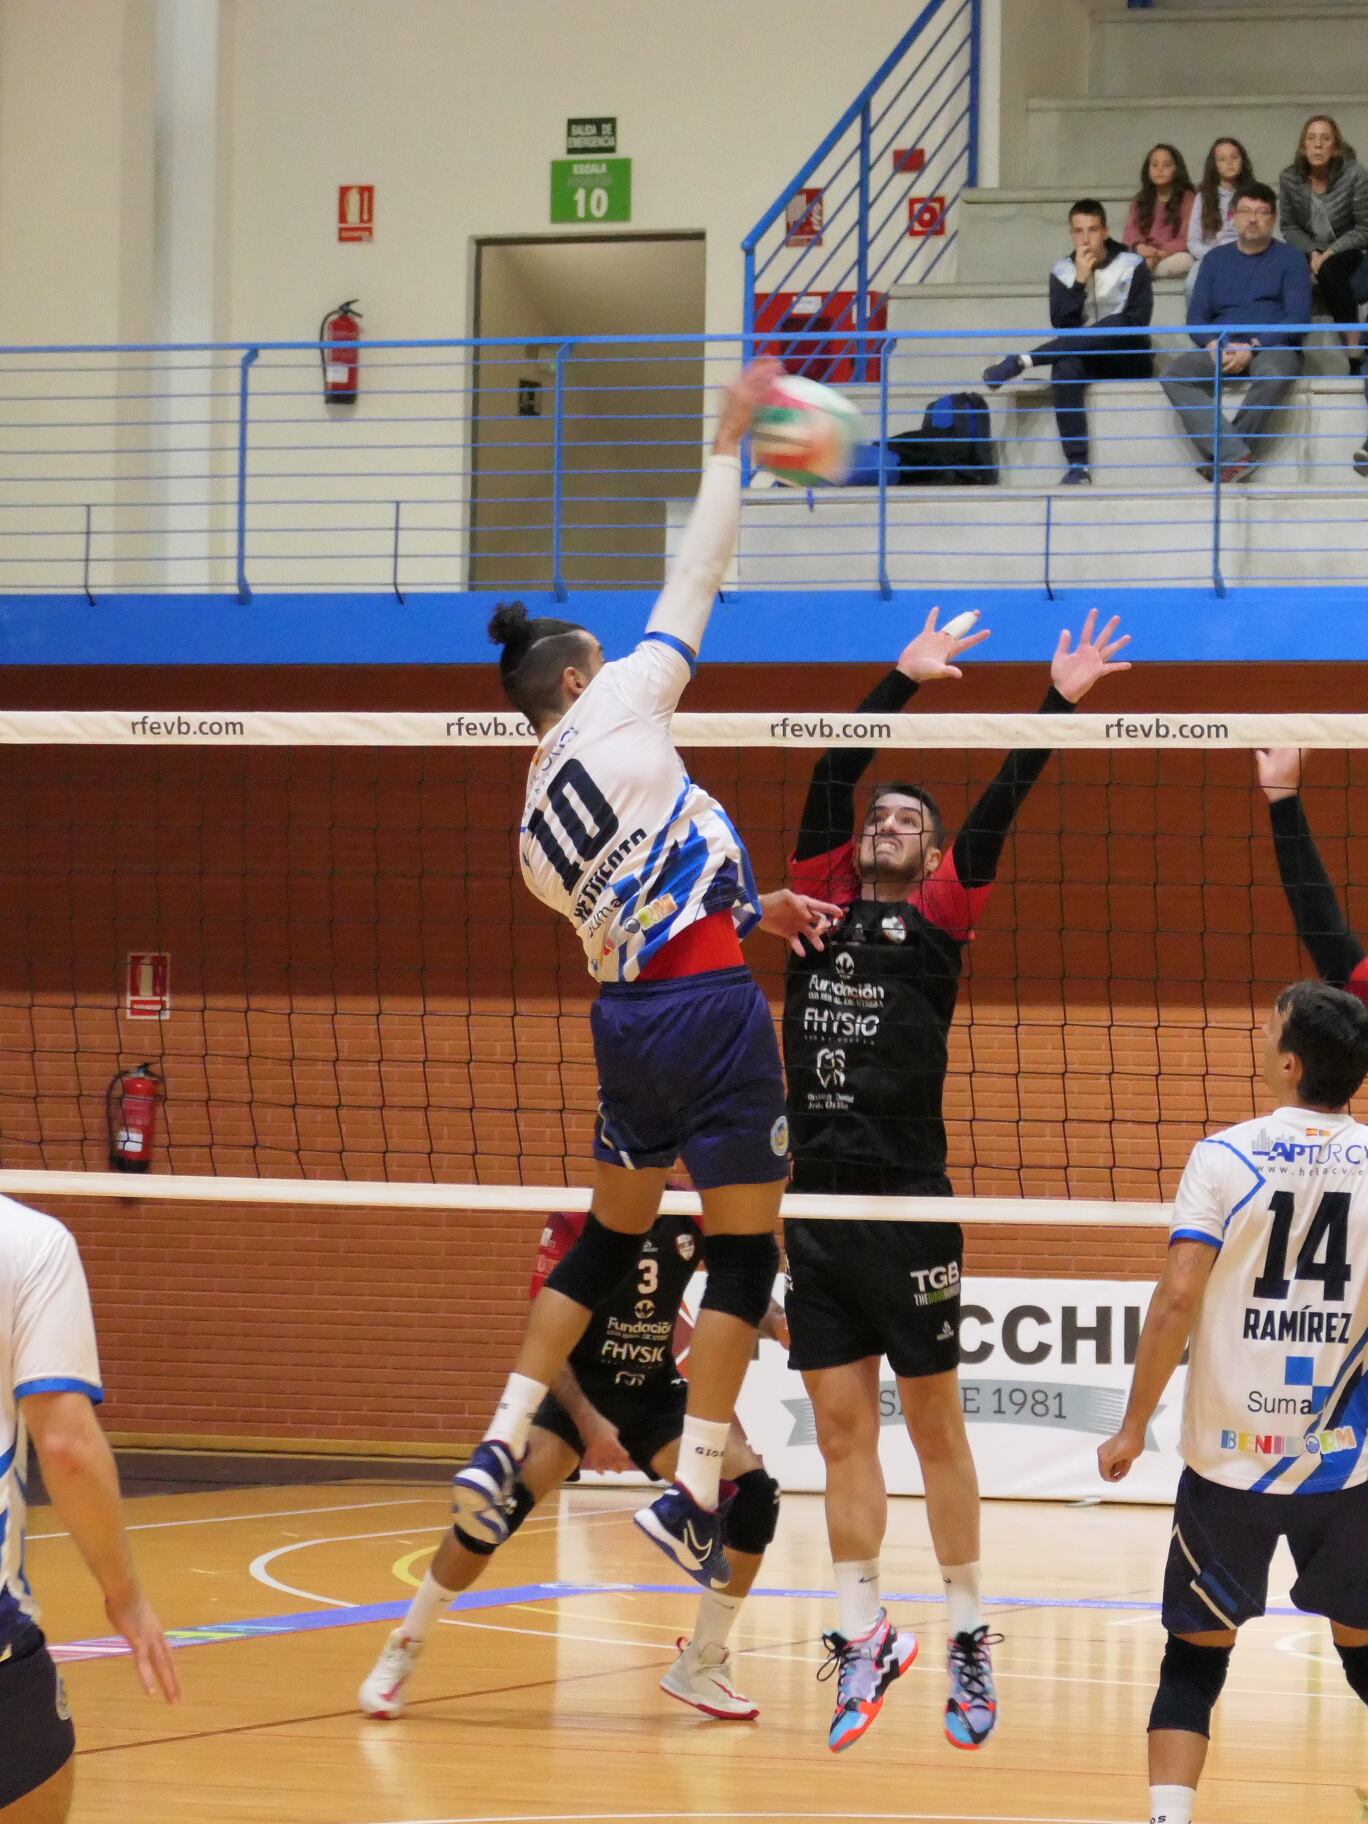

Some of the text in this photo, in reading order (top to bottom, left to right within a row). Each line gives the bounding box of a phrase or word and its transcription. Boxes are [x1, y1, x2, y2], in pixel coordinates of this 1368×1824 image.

[573, 187, 609, 218] 10
[131, 716, 244, 736] rfevb.com
[445, 717, 540, 737] rfevb.co
[769, 717, 892, 738] rfevb.com
[1104, 717, 1229, 739] rfevb.com
[527, 757, 620, 896] 10
[1252, 1189, 1353, 1302] 14
[637, 1258, 659, 1295] 3
[909, 1261, 960, 1293] TGB
[1242, 1304, 1353, 1345] RAMÍREZ
[990, 1386, 1068, 1420] 1981
[1247, 1390, 1313, 1415] Suma
